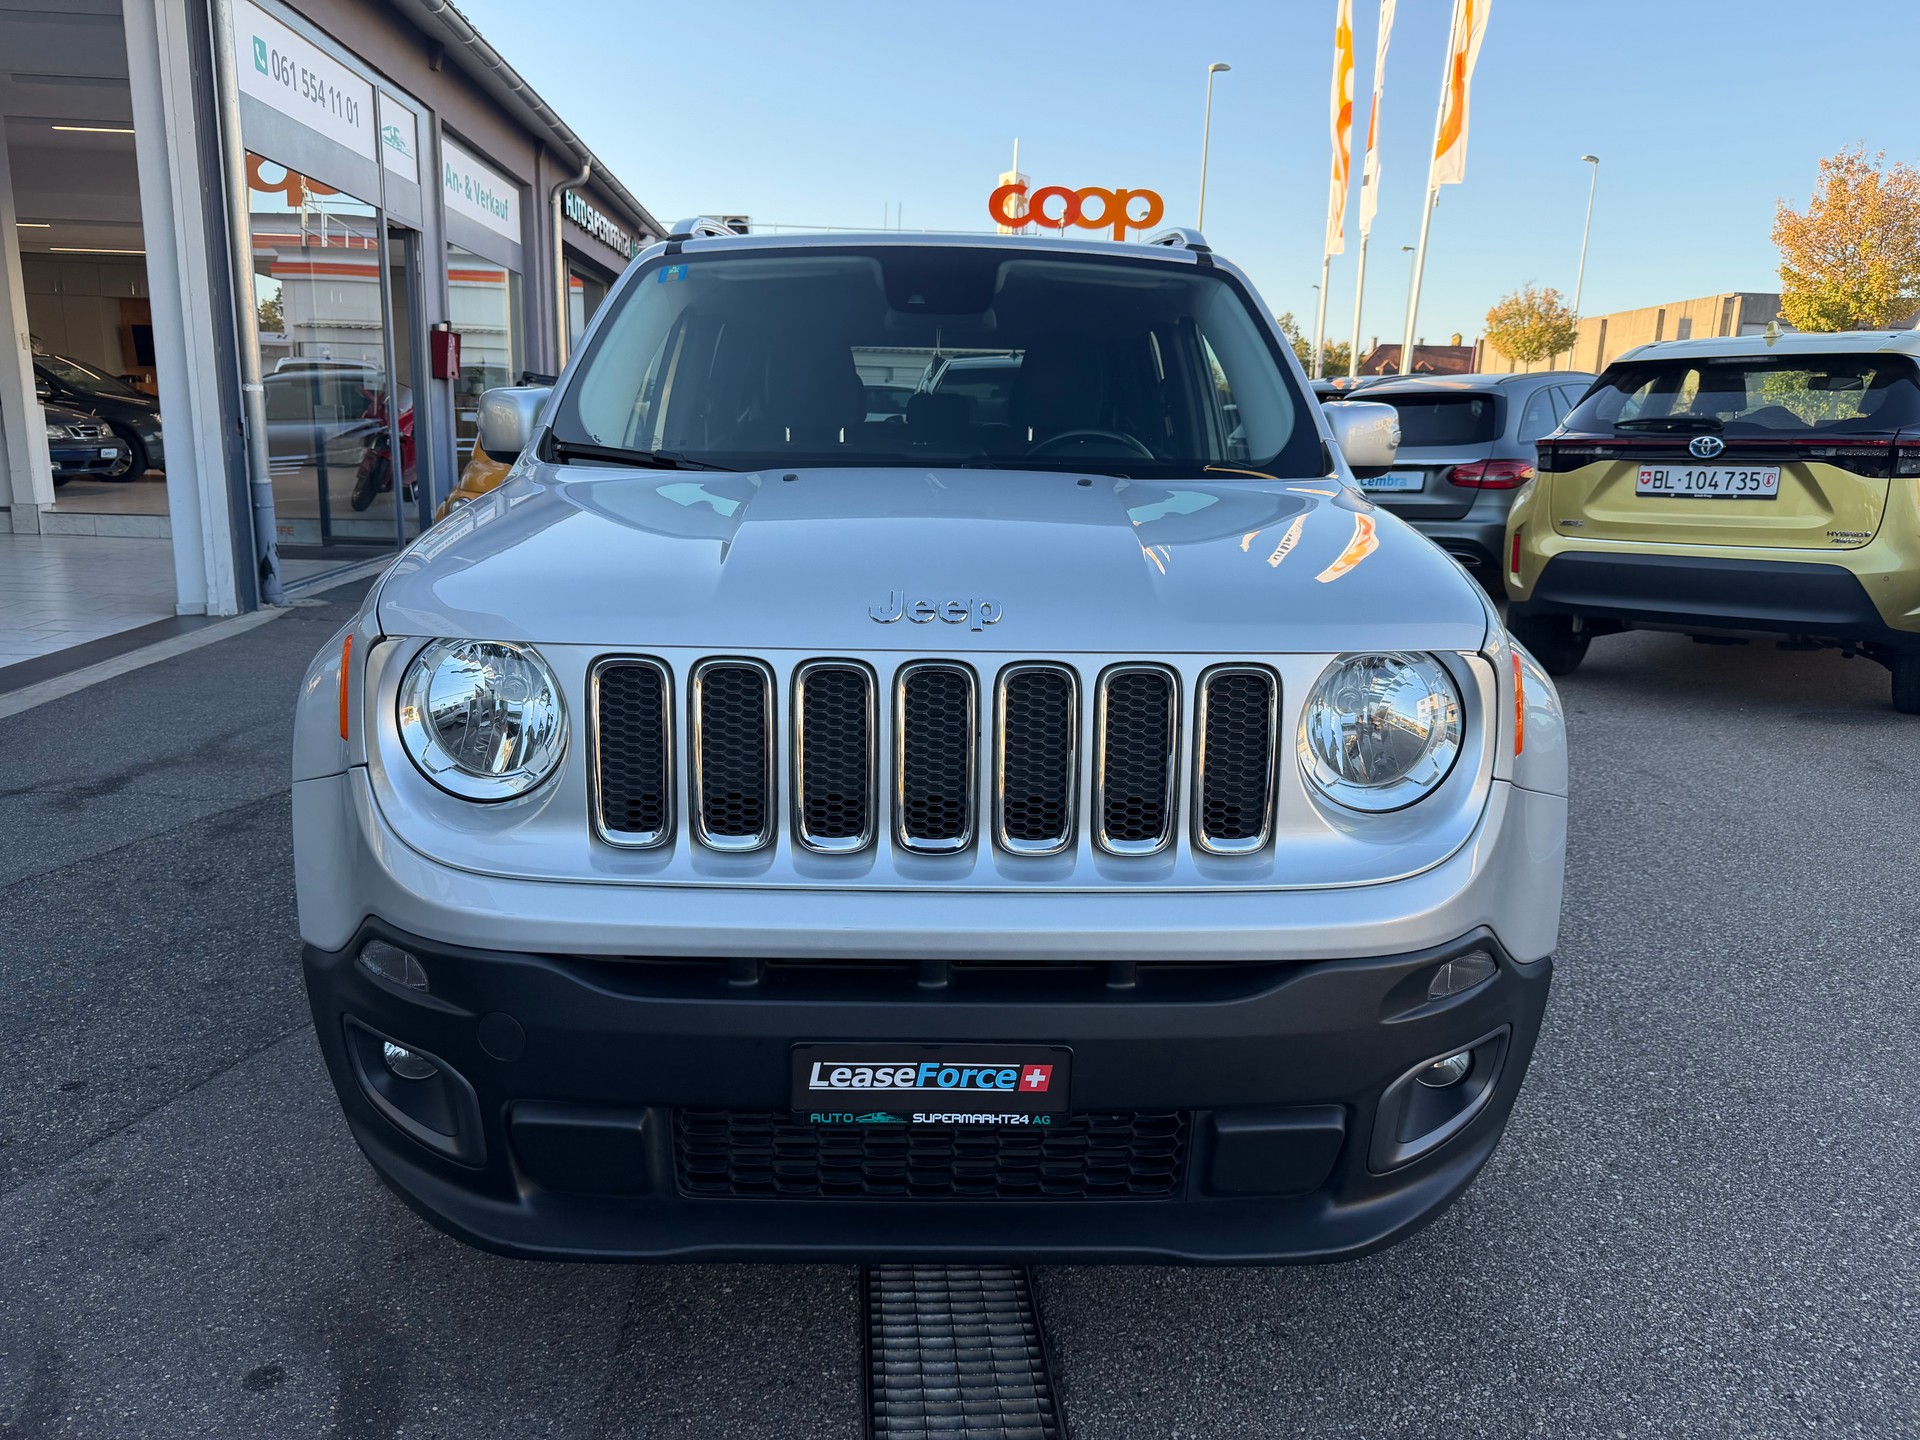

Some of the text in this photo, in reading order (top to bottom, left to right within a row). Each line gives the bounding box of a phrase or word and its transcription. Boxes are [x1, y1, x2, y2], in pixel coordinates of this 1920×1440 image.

[271, 49, 359, 129] 061 554 11 01
[445, 162, 508, 222] An- & Verkauf
[1360, 475, 1408, 487] Cembra
[868, 590, 1004, 632] Jeep
[808, 1061, 1018, 1089] LeaseForce
[810, 1113, 1051, 1125] AUTO SUPERMARKT24 AG
